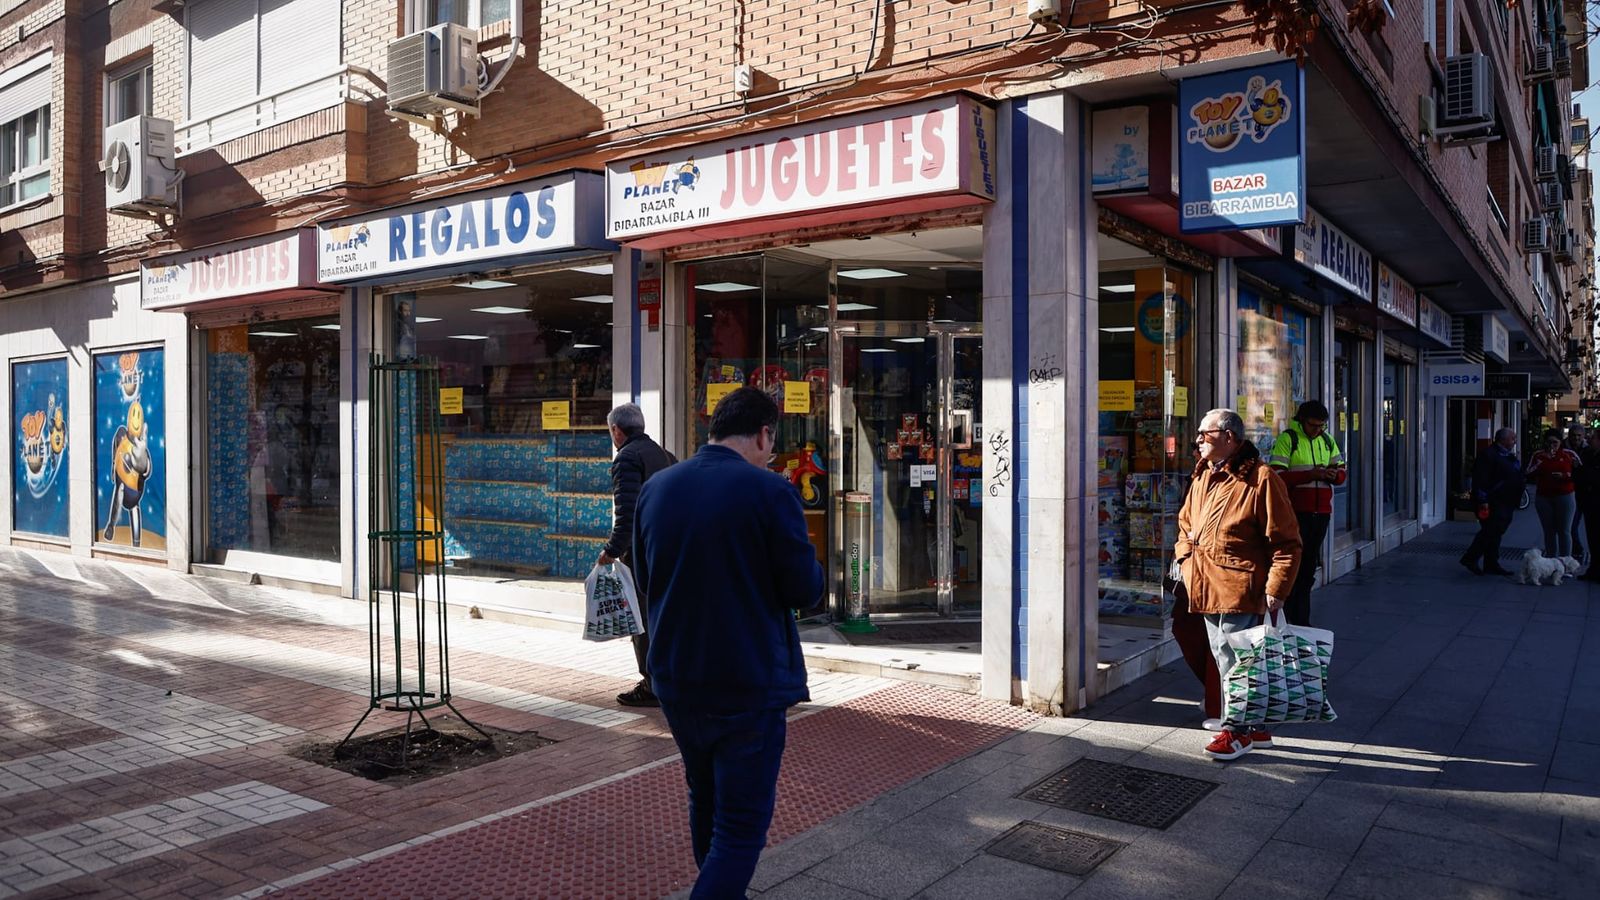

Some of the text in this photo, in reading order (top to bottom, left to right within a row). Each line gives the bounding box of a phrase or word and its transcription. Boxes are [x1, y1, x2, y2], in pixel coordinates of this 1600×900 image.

[1194, 96, 1242, 124] TOY
[1190, 119, 1252, 140] PLANET
[720, 109, 945, 209] JUGUETES
[972, 105, 993, 195] JUGUETES
[624, 179, 680, 199] PLANET
[1213, 176, 1264, 192] BAZAR
[640, 198, 675, 213] BAZAR
[1185, 194, 1295, 216] BIBARRAMBLA
[389, 185, 556, 262] REGALOS
[614, 207, 710, 231] BIBARRAMBLA III
[325, 237, 359, 253] PLANET
[188, 239, 290, 295] JUGUETES
[1321, 223, 1370, 294] REGALOS
[1433, 376, 1470, 385] asisa
[21, 410, 46, 441] TOY
